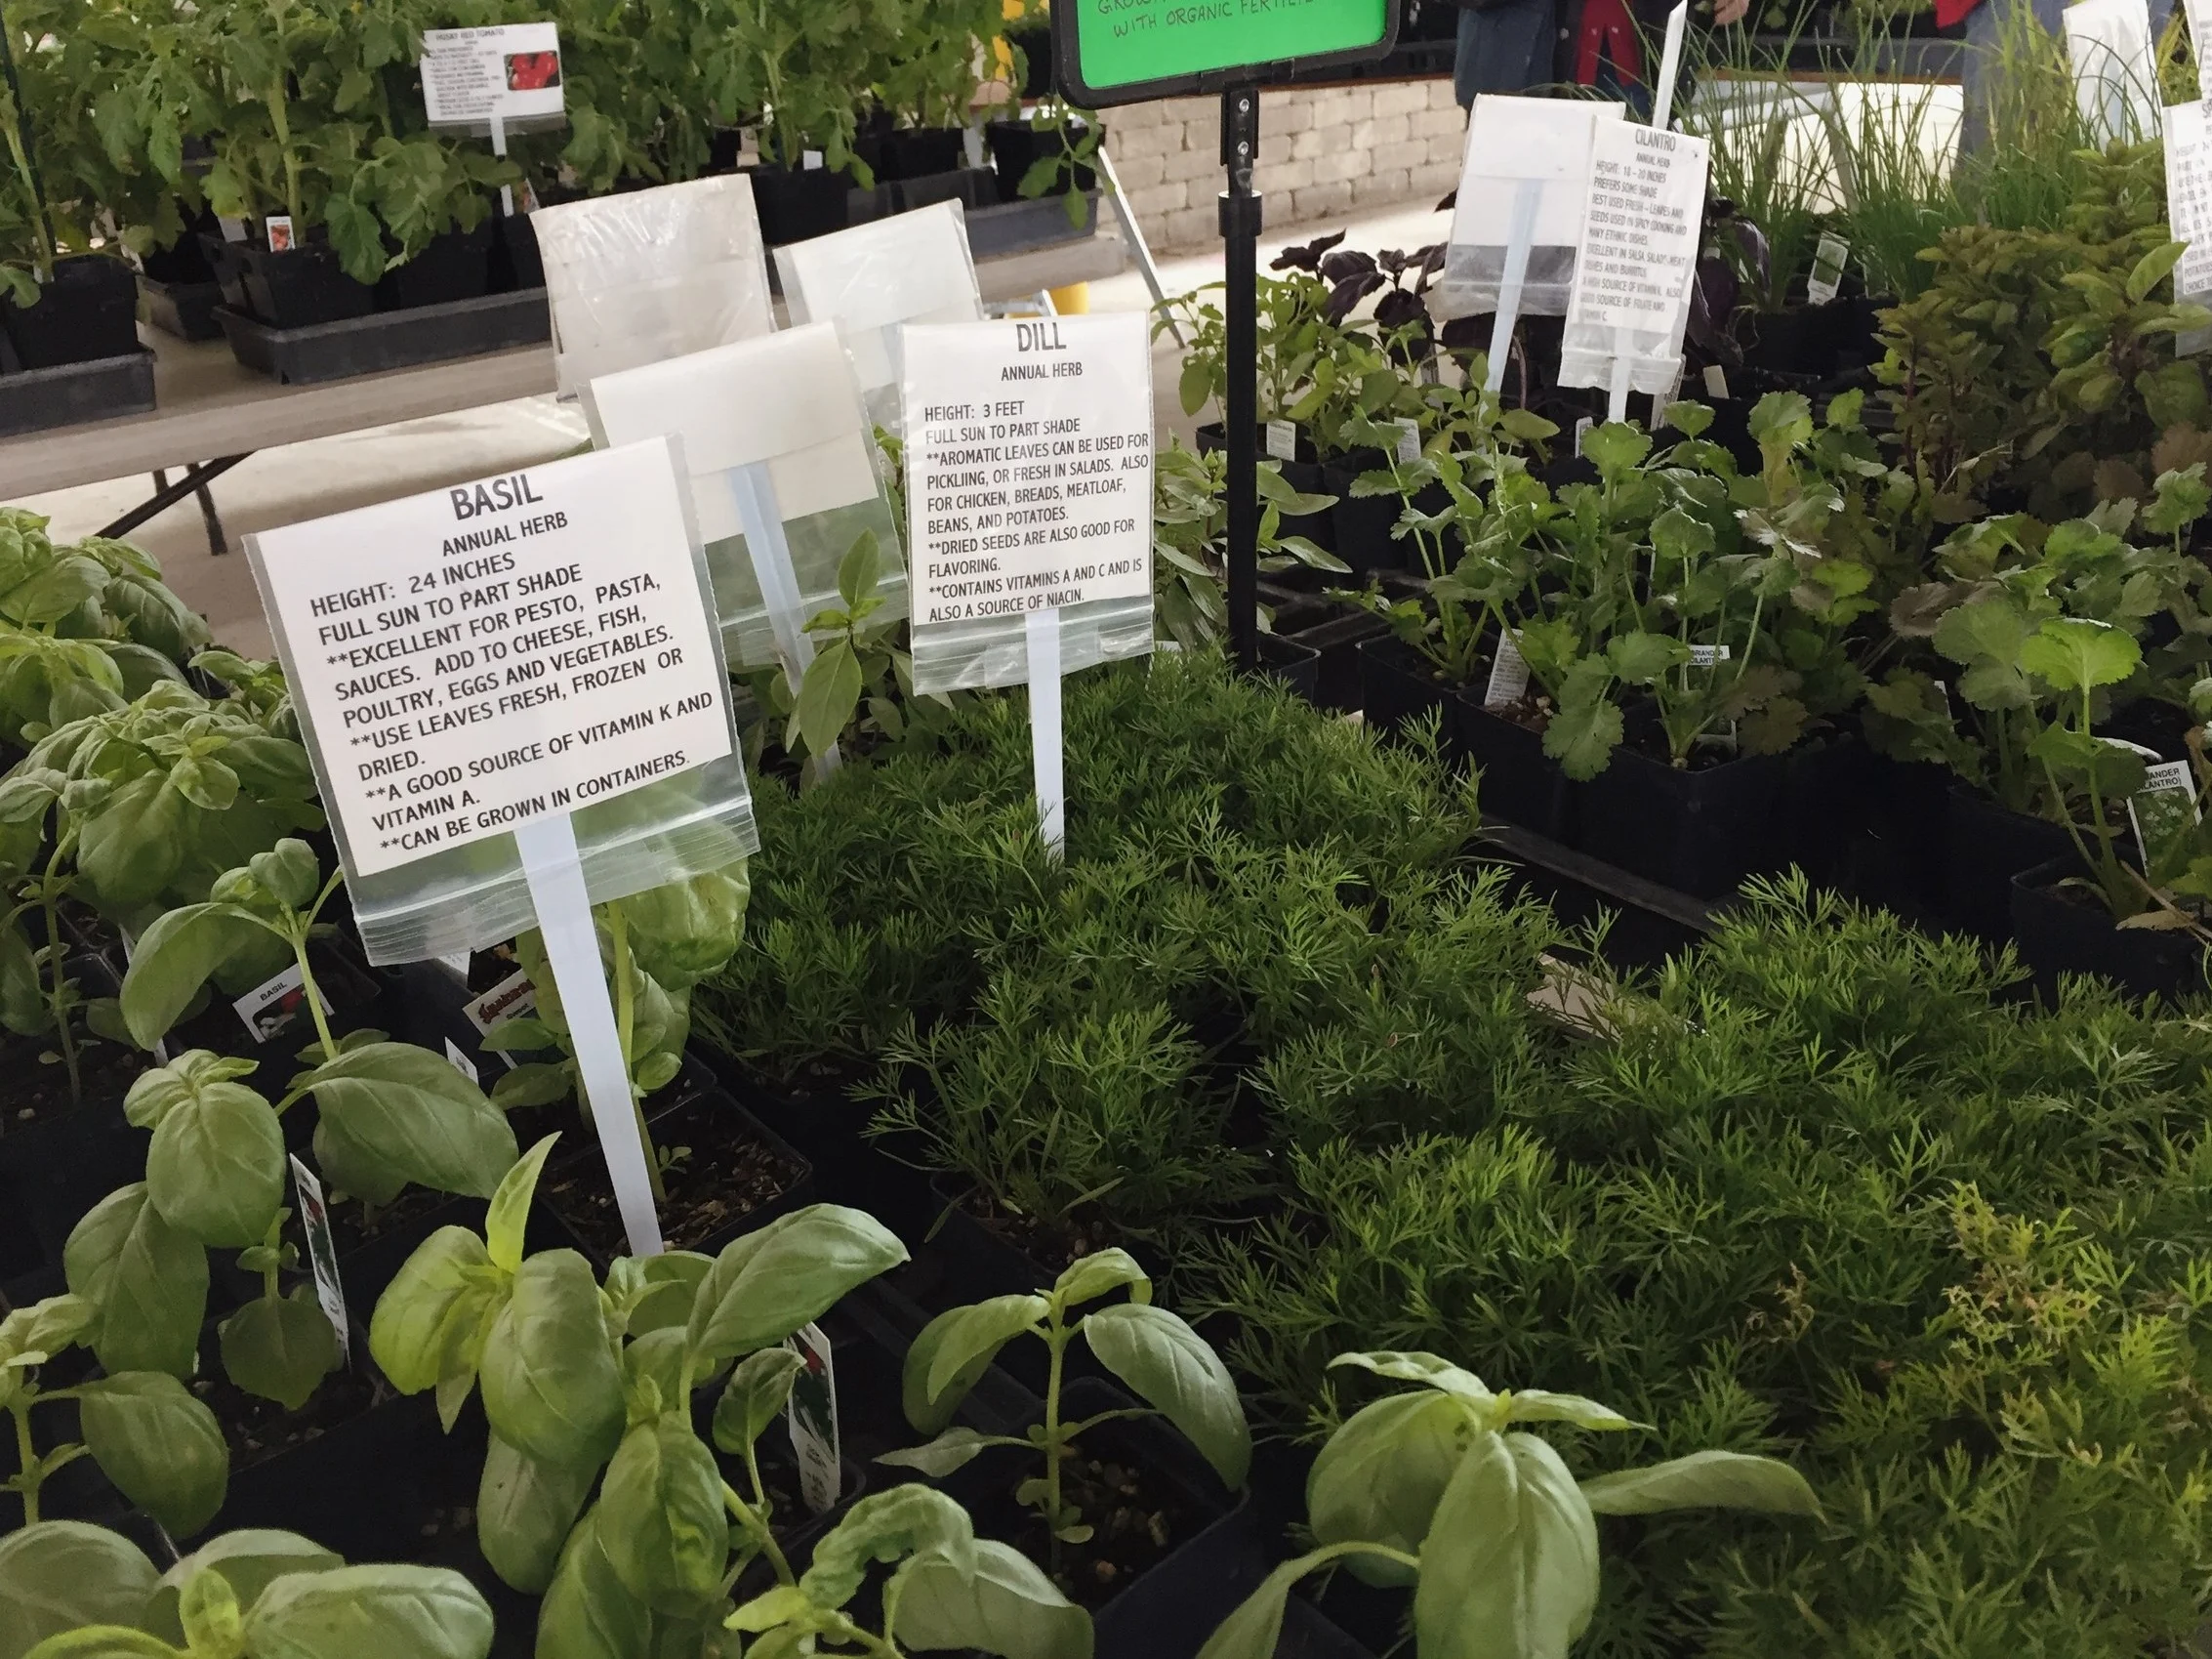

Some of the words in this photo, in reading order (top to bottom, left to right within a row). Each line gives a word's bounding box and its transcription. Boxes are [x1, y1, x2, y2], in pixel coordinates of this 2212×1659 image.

[1113, 13, 1157, 38] WITH
[1167, 2, 1233, 25] ORGANIC
[1635, 130, 1676, 151] CILANTRO
[1593, 176, 1620, 191] PREFERS
[1601, 277, 1627, 291] SOURCE
[1015, 321, 1068, 353] DILL
[1001, 363, 1050, 382] ANNUAL
[1051, 360, 1084, 379] HERB
[923, 403, 975, 423] HEIGHT:
[982, 403, 992, 419] 3
[995, 399, 1025, 418] FEET
[925, 428, 959, 445] FULL
[960, 426, 987, 442] SUN
[988, 424, 1006, 440] TO
[1008, 421, 1041, 438] PART
[1043, 417, 1082, 435] SHADE
[1004, 441, 1050, 462] LEAVES
[1051, 439, 1075, 457] CAN
[1077, 437, 1093, 454] BE
[1095, 435, 1125, 452] USED
[1126, 433, 1149, 449] FOR
[992, 468, 1010, 484] OR
[1013, 464, 1051, 482] FRESH
[1054, 462, 1067, 478] IN
[1069, 457, 1115, 477] SALADS.
[1120, 453, 1149, 471] ALSO
[449, 473, 545, 521] BASIL
[926, 495, 954, 514] FOR
[956, 490, 1011, 511] CHICKEN,
[1014, 484, 1064, 505] BREADS,
[1066, 477, 1126, 499] MEATLOAF,
[442, 524, 517, 558] ANNUAL
[518, 511, 569, 538] HERB
[927, 516, 973, 535] BEANS,
[975, 513, 1003, 530] AND
[1005, 505, 1069, 529] POTATOES.
[980, 532, 1021, 552] SEEDS
[1023, 529, 1047, 547] ARE
[1048, 525, 1079, 544] ALSO
[1080, 520, 1111, 539] GOOD
[1113, 518, 1135, 534] FOR
[309, 581, 396, 618] HEIGHT:
[407, 571, 437, 595] 24
[441, 551, 516, 586] INCHES
[928, 557, 1002, 579] FLAVORING.
[1005, 569, 1060, 592] VITAMINS
[1062, 568, 1071, 584] A
[1072, 564, 1096, 583] AND
[1097, 562, 1106, 578] C
[1107, 560, 1130, 577] AND
[1132, 558, 1143, 573] IS
[317, 617, 374, 646] FULL
[376, 603, 421, 632] SUN
[423, 597, 455, 619] TO
[459, 580, 511, 611] PART
[515, 562, 584, 597] SHADE
[468, 611, 512, 639] FOR
[513, 594, 585, 626] PESTO,
[594, 572, 661, 605] PASTA,
[929, 605, 962, 622] ALSO
[965, 603, 974, 617] A
[977, 598, 1025, 616] SOURCE
[1028, 595, 1044, 609] OF
[1046, 588, 1085, 606] NIACIN.
[334, 665, 422, 702] SAUCES.
[434, 649, 475, 677] ADD
[477, 641, 508, 664] TO
[512, 618, 594, 654] CHEESE,
[597, 603, 647, 633] FISH,
[342, 687, 443, 729] POULTRY,
[447, 671, 500, 701] EGGS
[506, 659, 546, 686] AND
[548, 624, 674, 673] VEGETABLES.
[417, 701, 494, 737] LEAVES
[498, 682, 567, 716] FRESH,
[570, 657, 647, 695] FROZEN
[657, 646, 684, 670] OR
[406, 766, 464, 796] GOOD
[468, 742, 545, 778] SOURCE
[548, 732, 574, 755] OF
[577, 709, 655, 745] VITAMIN
[658, 703, 674, 723] K
[676, 691, 714, 718] AND
[357, 749, 427, 782] DRIED.
[371, 793, 456, 832] VITAMIN
[461, 789, 481, 809] A.
[444, 815, 472, 839] BE
[476, 795, 547, 829] GROWN
[551, 787, 572, 809] IN
[575, 749, 690, 800] CONTAINERS.
[260, 981, 288, 1002] BASIL
